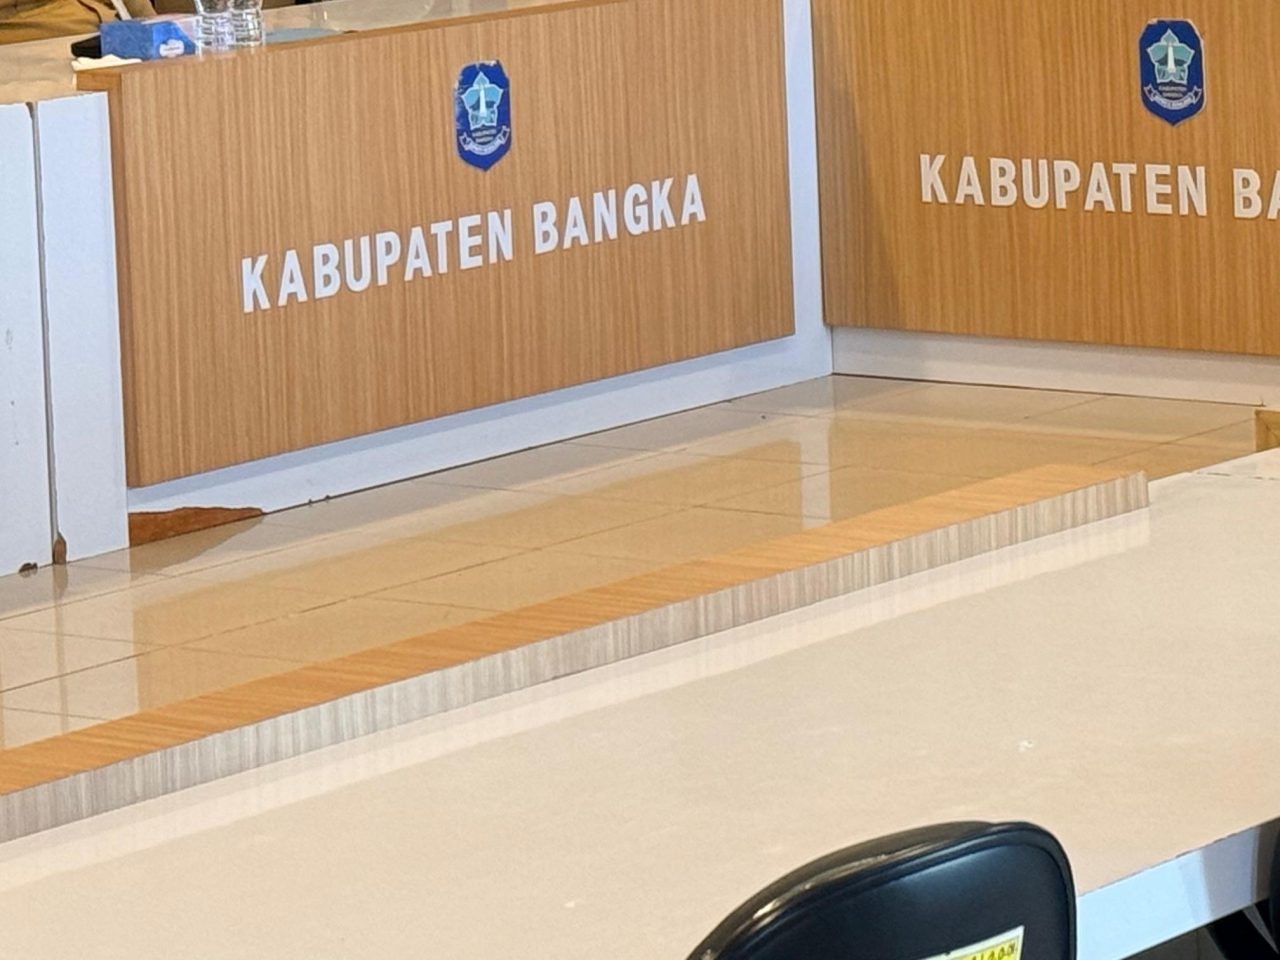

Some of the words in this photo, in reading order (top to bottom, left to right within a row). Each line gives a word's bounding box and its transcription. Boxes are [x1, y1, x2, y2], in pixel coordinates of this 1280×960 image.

[919, 153, 1208, 217] KABUPATEN
[241, 208, 514, 313] KABUPATEN
[533, 173, 706, 255] BANGKA
